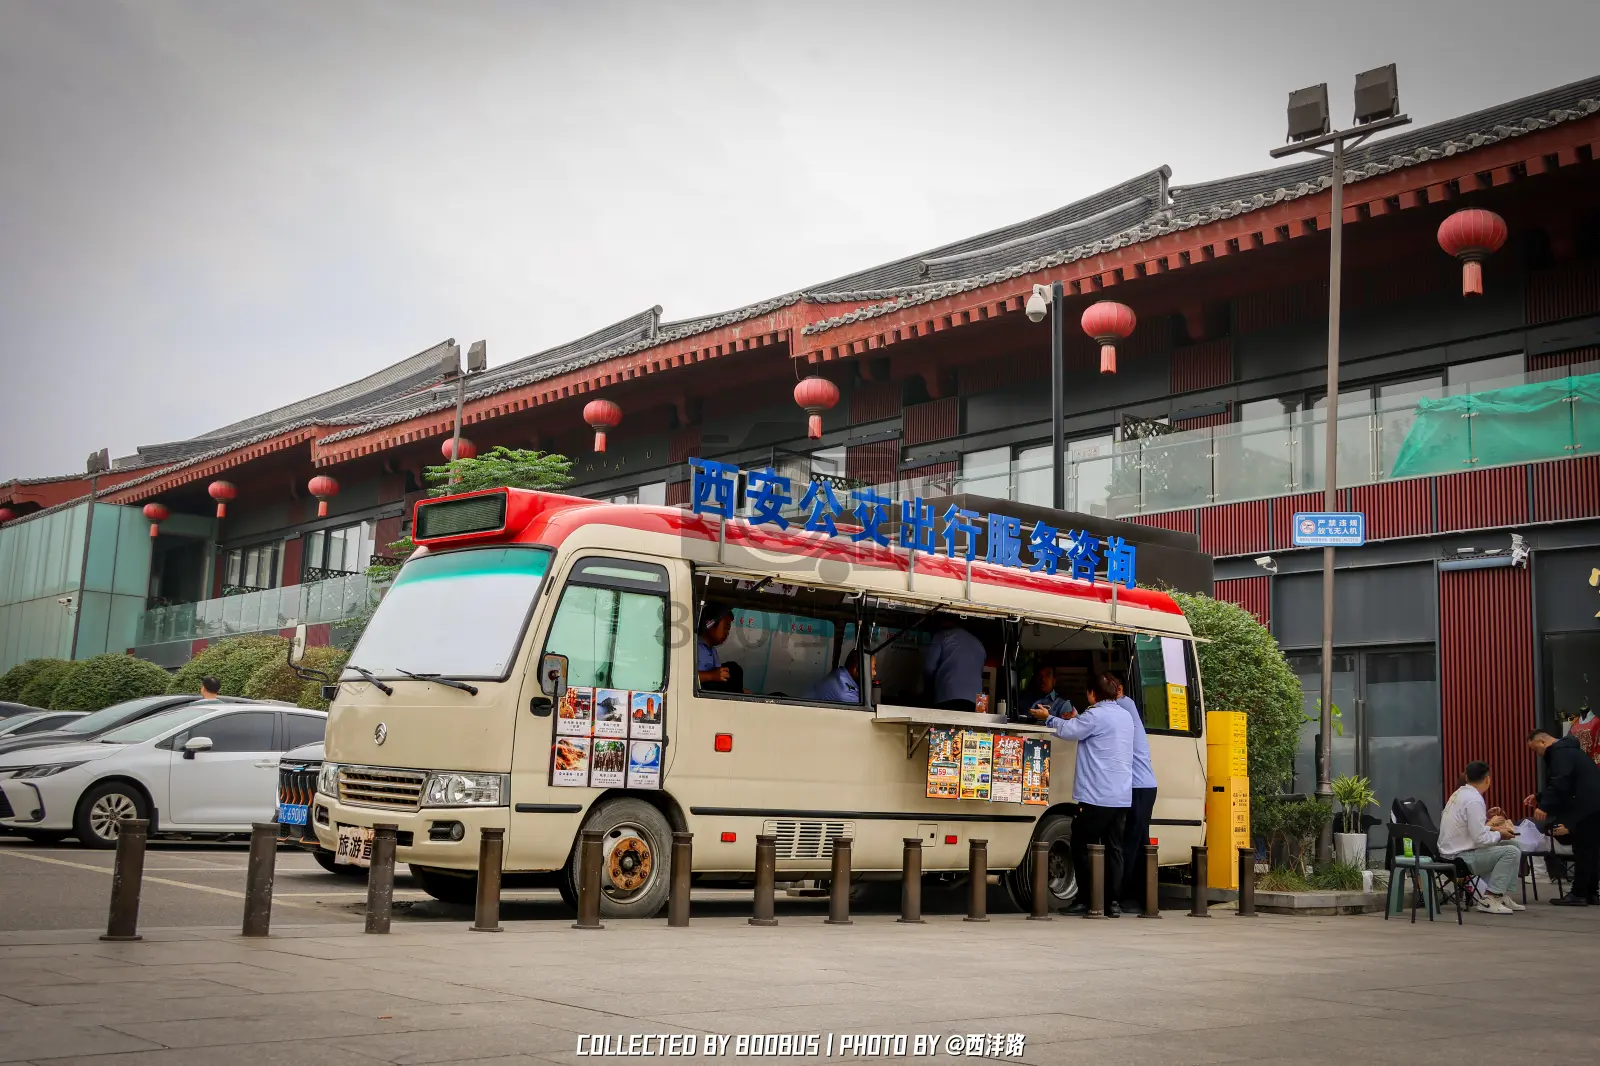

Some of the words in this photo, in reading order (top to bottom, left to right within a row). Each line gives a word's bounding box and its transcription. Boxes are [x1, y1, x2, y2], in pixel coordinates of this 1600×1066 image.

[688, 456, 1137, 589] 西安公交出行服务咨询
[1317, 519, 1358, 527] 严禁违规
[1317, 527, 1358, 535] 放飞无人机
[937, 768, 947, 776] 59
